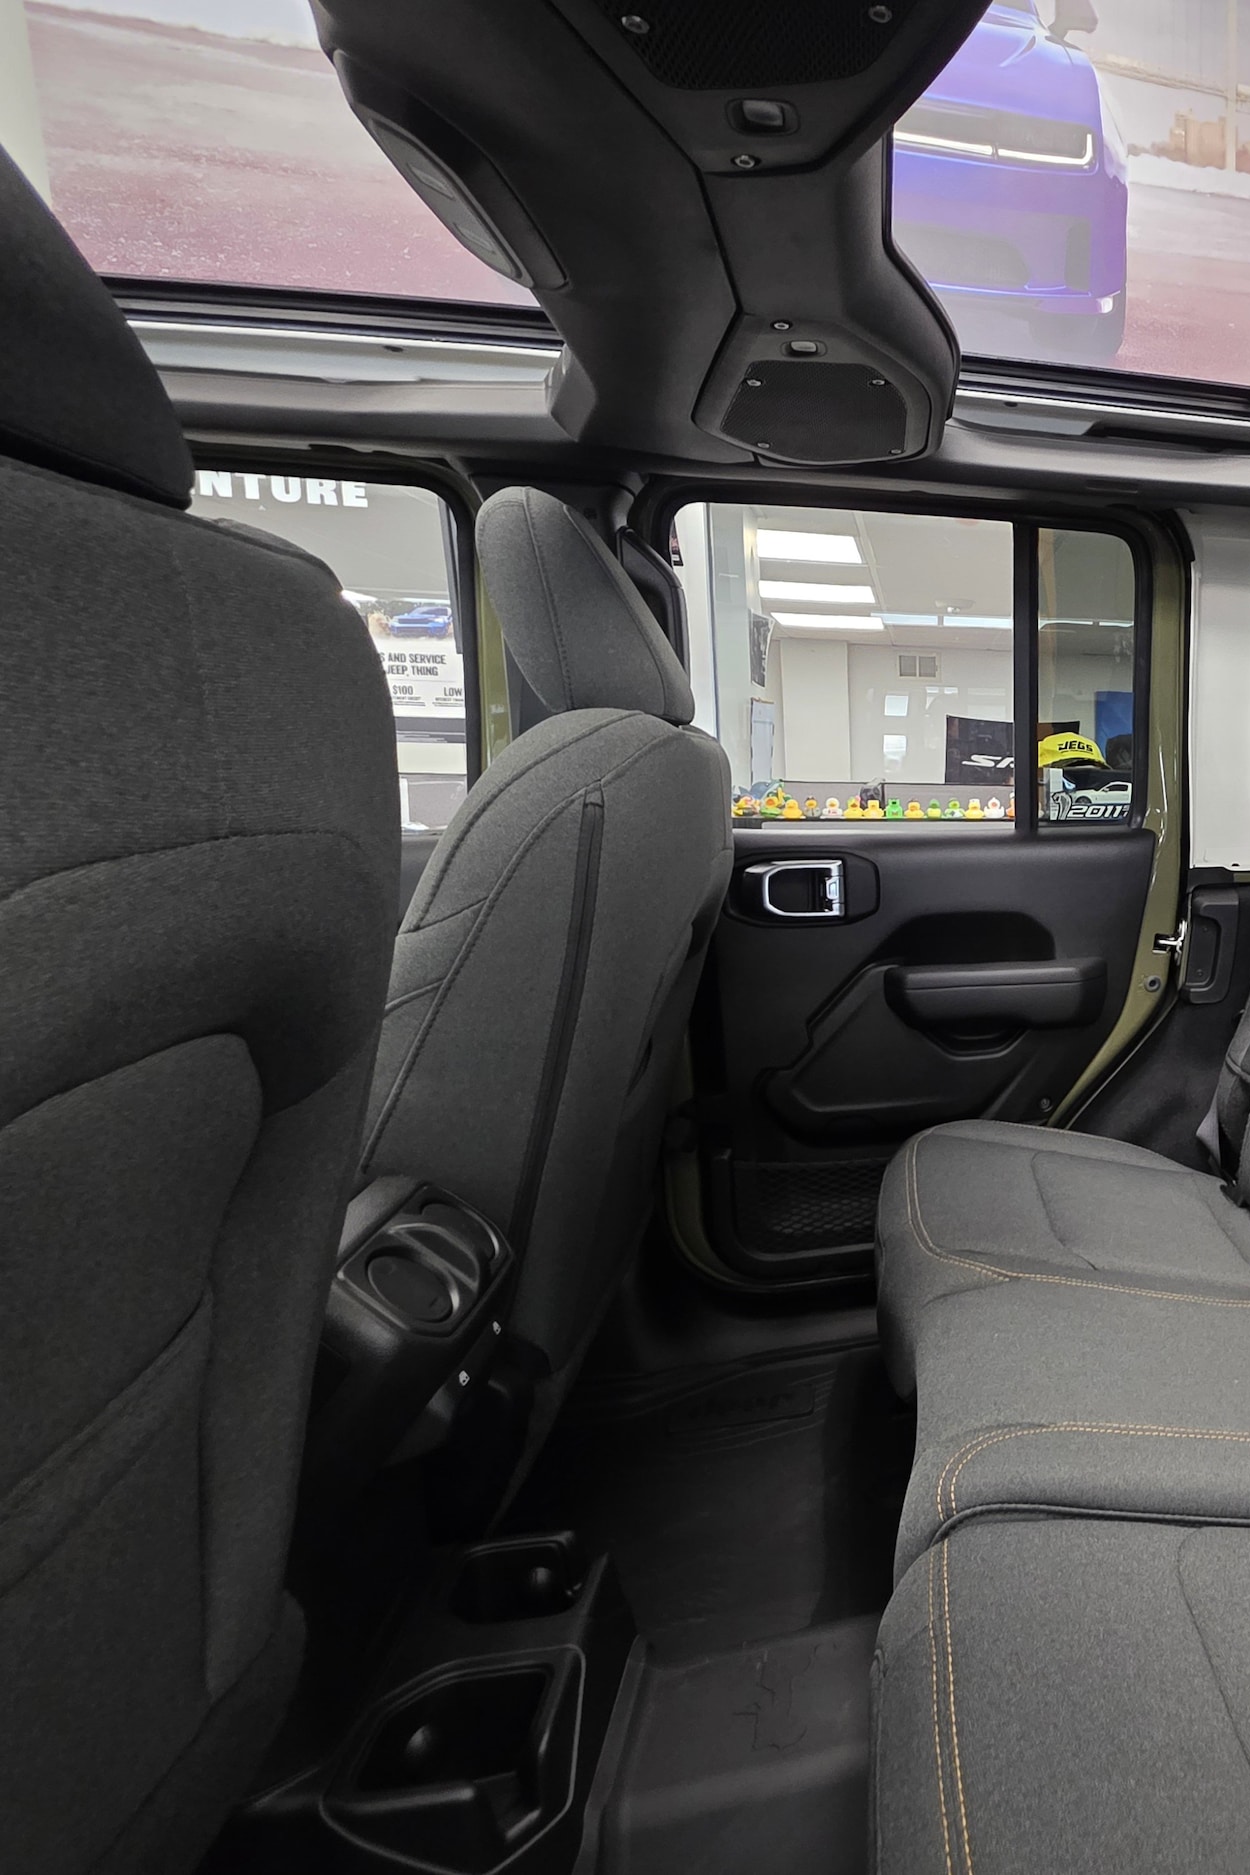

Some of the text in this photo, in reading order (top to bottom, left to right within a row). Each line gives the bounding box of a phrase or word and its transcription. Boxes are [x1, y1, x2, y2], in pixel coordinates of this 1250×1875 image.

[191, 469, 369, 508] NTURE
[388, 652, 406, 663] AND
[409, 653, 447, 665] SERVICE
[411, 665, 439, 676] THING
[392, 684, 414, 695] $100
[443, 686, 463, 697] LOW
[1058, 740, 1093, 753] JEGS
[1067, 805, 1123, 818] 2011
